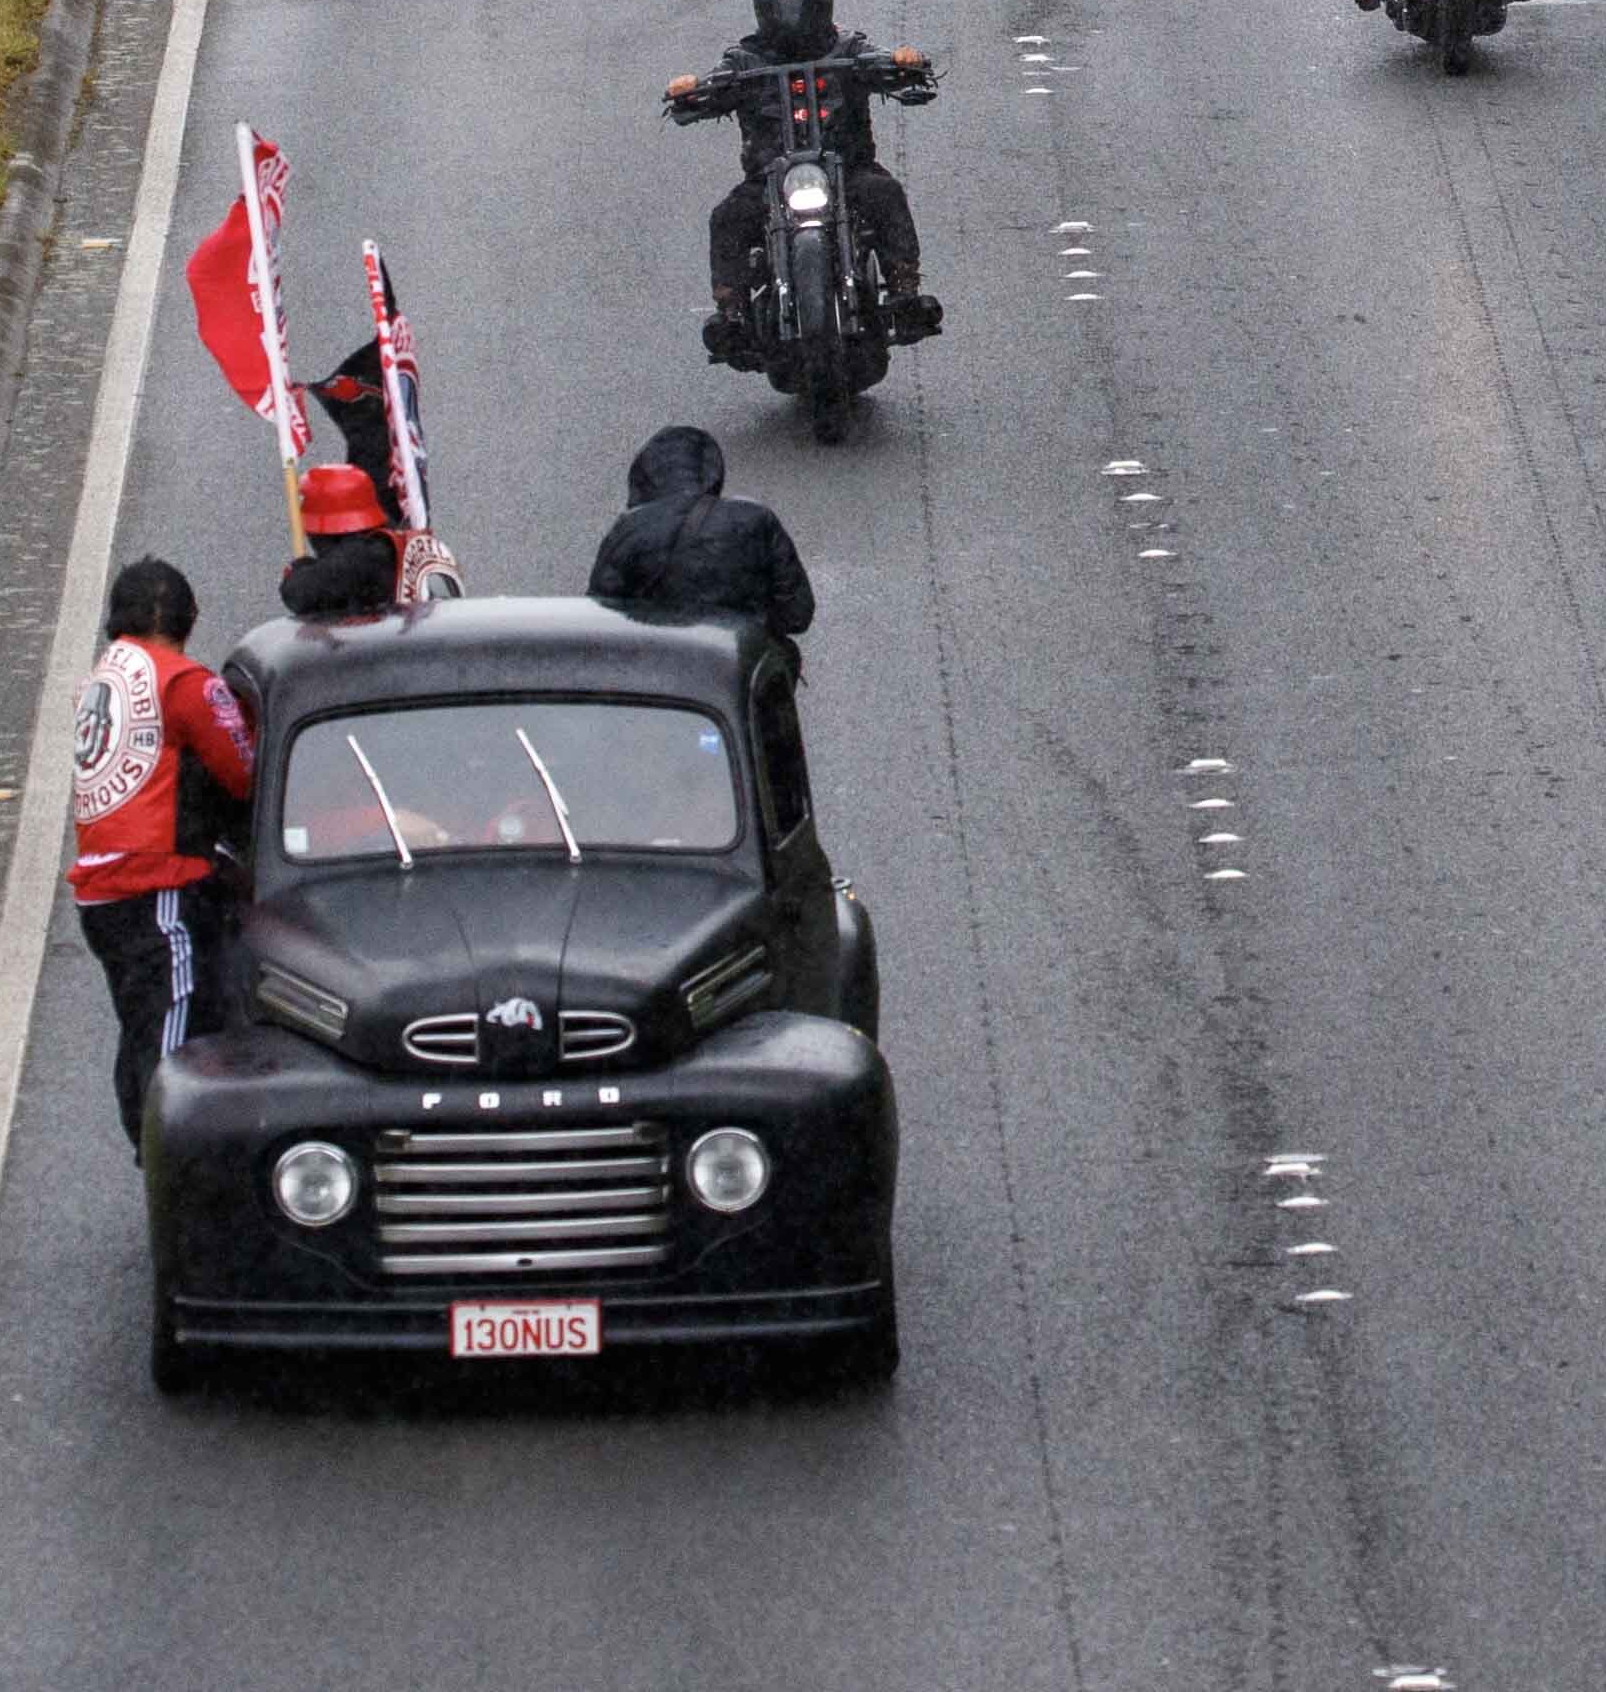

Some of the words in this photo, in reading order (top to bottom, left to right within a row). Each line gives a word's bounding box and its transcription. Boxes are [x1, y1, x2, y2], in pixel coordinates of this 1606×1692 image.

[129, 667, 152, 717] MOB
[133, 731, 156, 748] HB
[421, 1086, 621, 1109] FORD
